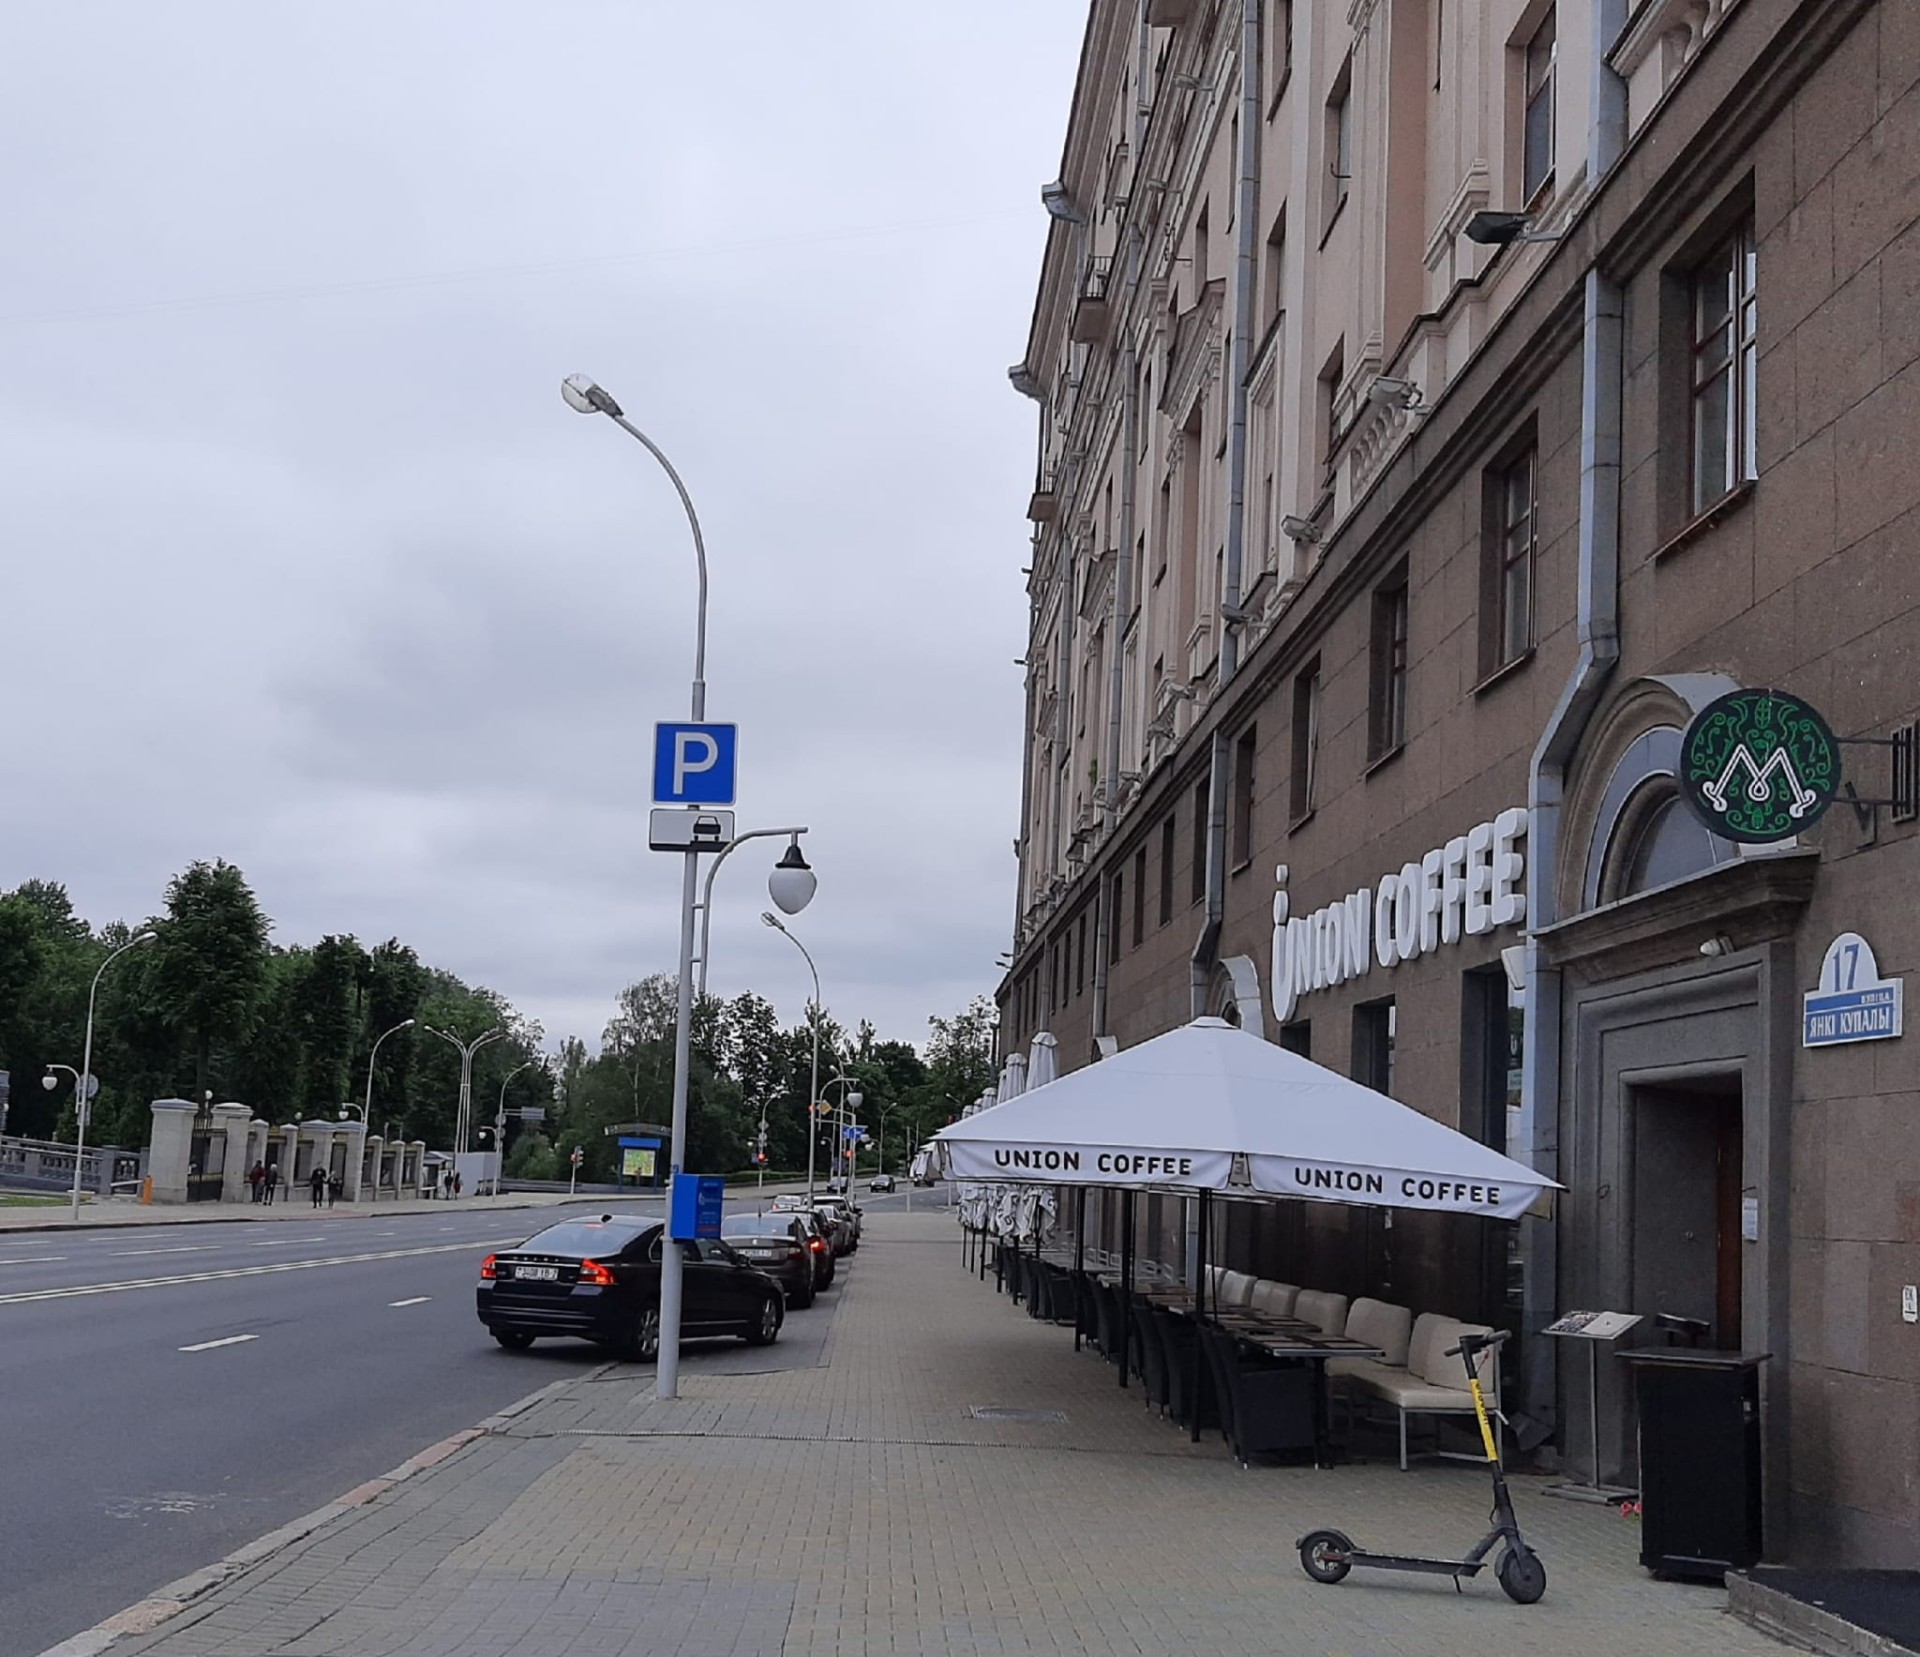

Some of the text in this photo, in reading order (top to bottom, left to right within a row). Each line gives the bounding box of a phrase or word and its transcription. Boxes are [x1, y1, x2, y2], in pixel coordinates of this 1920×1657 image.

[672, 731, 719, 795] P
[1375, 807, 1529, 968] COFFEE
[1832, 943, 1860, 992] 17
[1809, 1006, 1890, 1038] ЯНКІ КУПАЛЫ
[994, 1150, 1193, 1176] UNION COFFEE
[1294, 1166, 1501, 1205] UNION COFFEE
